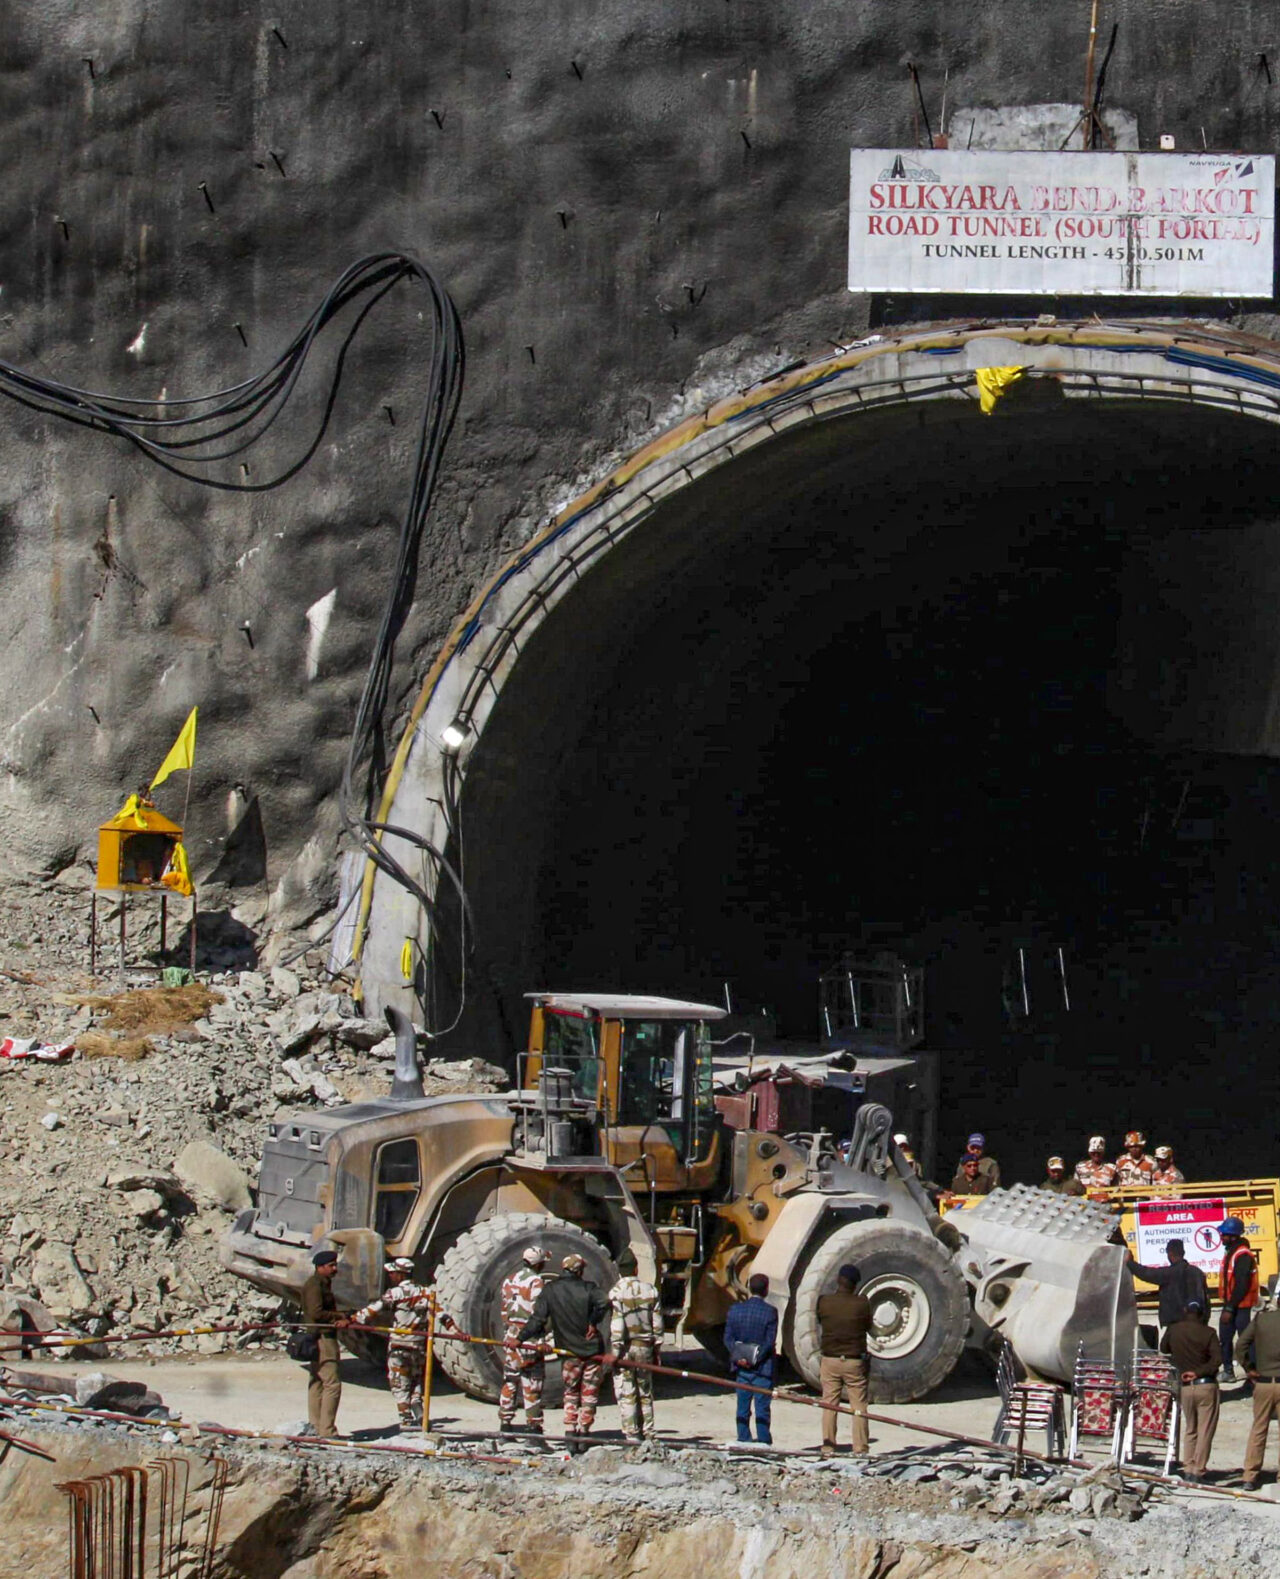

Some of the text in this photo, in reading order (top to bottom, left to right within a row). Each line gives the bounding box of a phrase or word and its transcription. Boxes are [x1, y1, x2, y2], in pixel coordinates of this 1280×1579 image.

[870, 184, 1022, 211] SILKYARA
[868, 215, 939, 236] ROAD
[947, 216, 1047, 238] TUNNEL
[1158, 218, 1261, 245] PORTAL)
[922, 244, 1000, 258] TUNNEL
[1007, 245, 1086, 259] LENGTH
[1148, 1201, 1213, 1213] RESTRICTED
[1166, 1213, 1195, 1222] AREA
[1144, 1228, 1192, 1237] AUTHORIZED
[1145, 1237, 1191, 1245] PERSOEL
